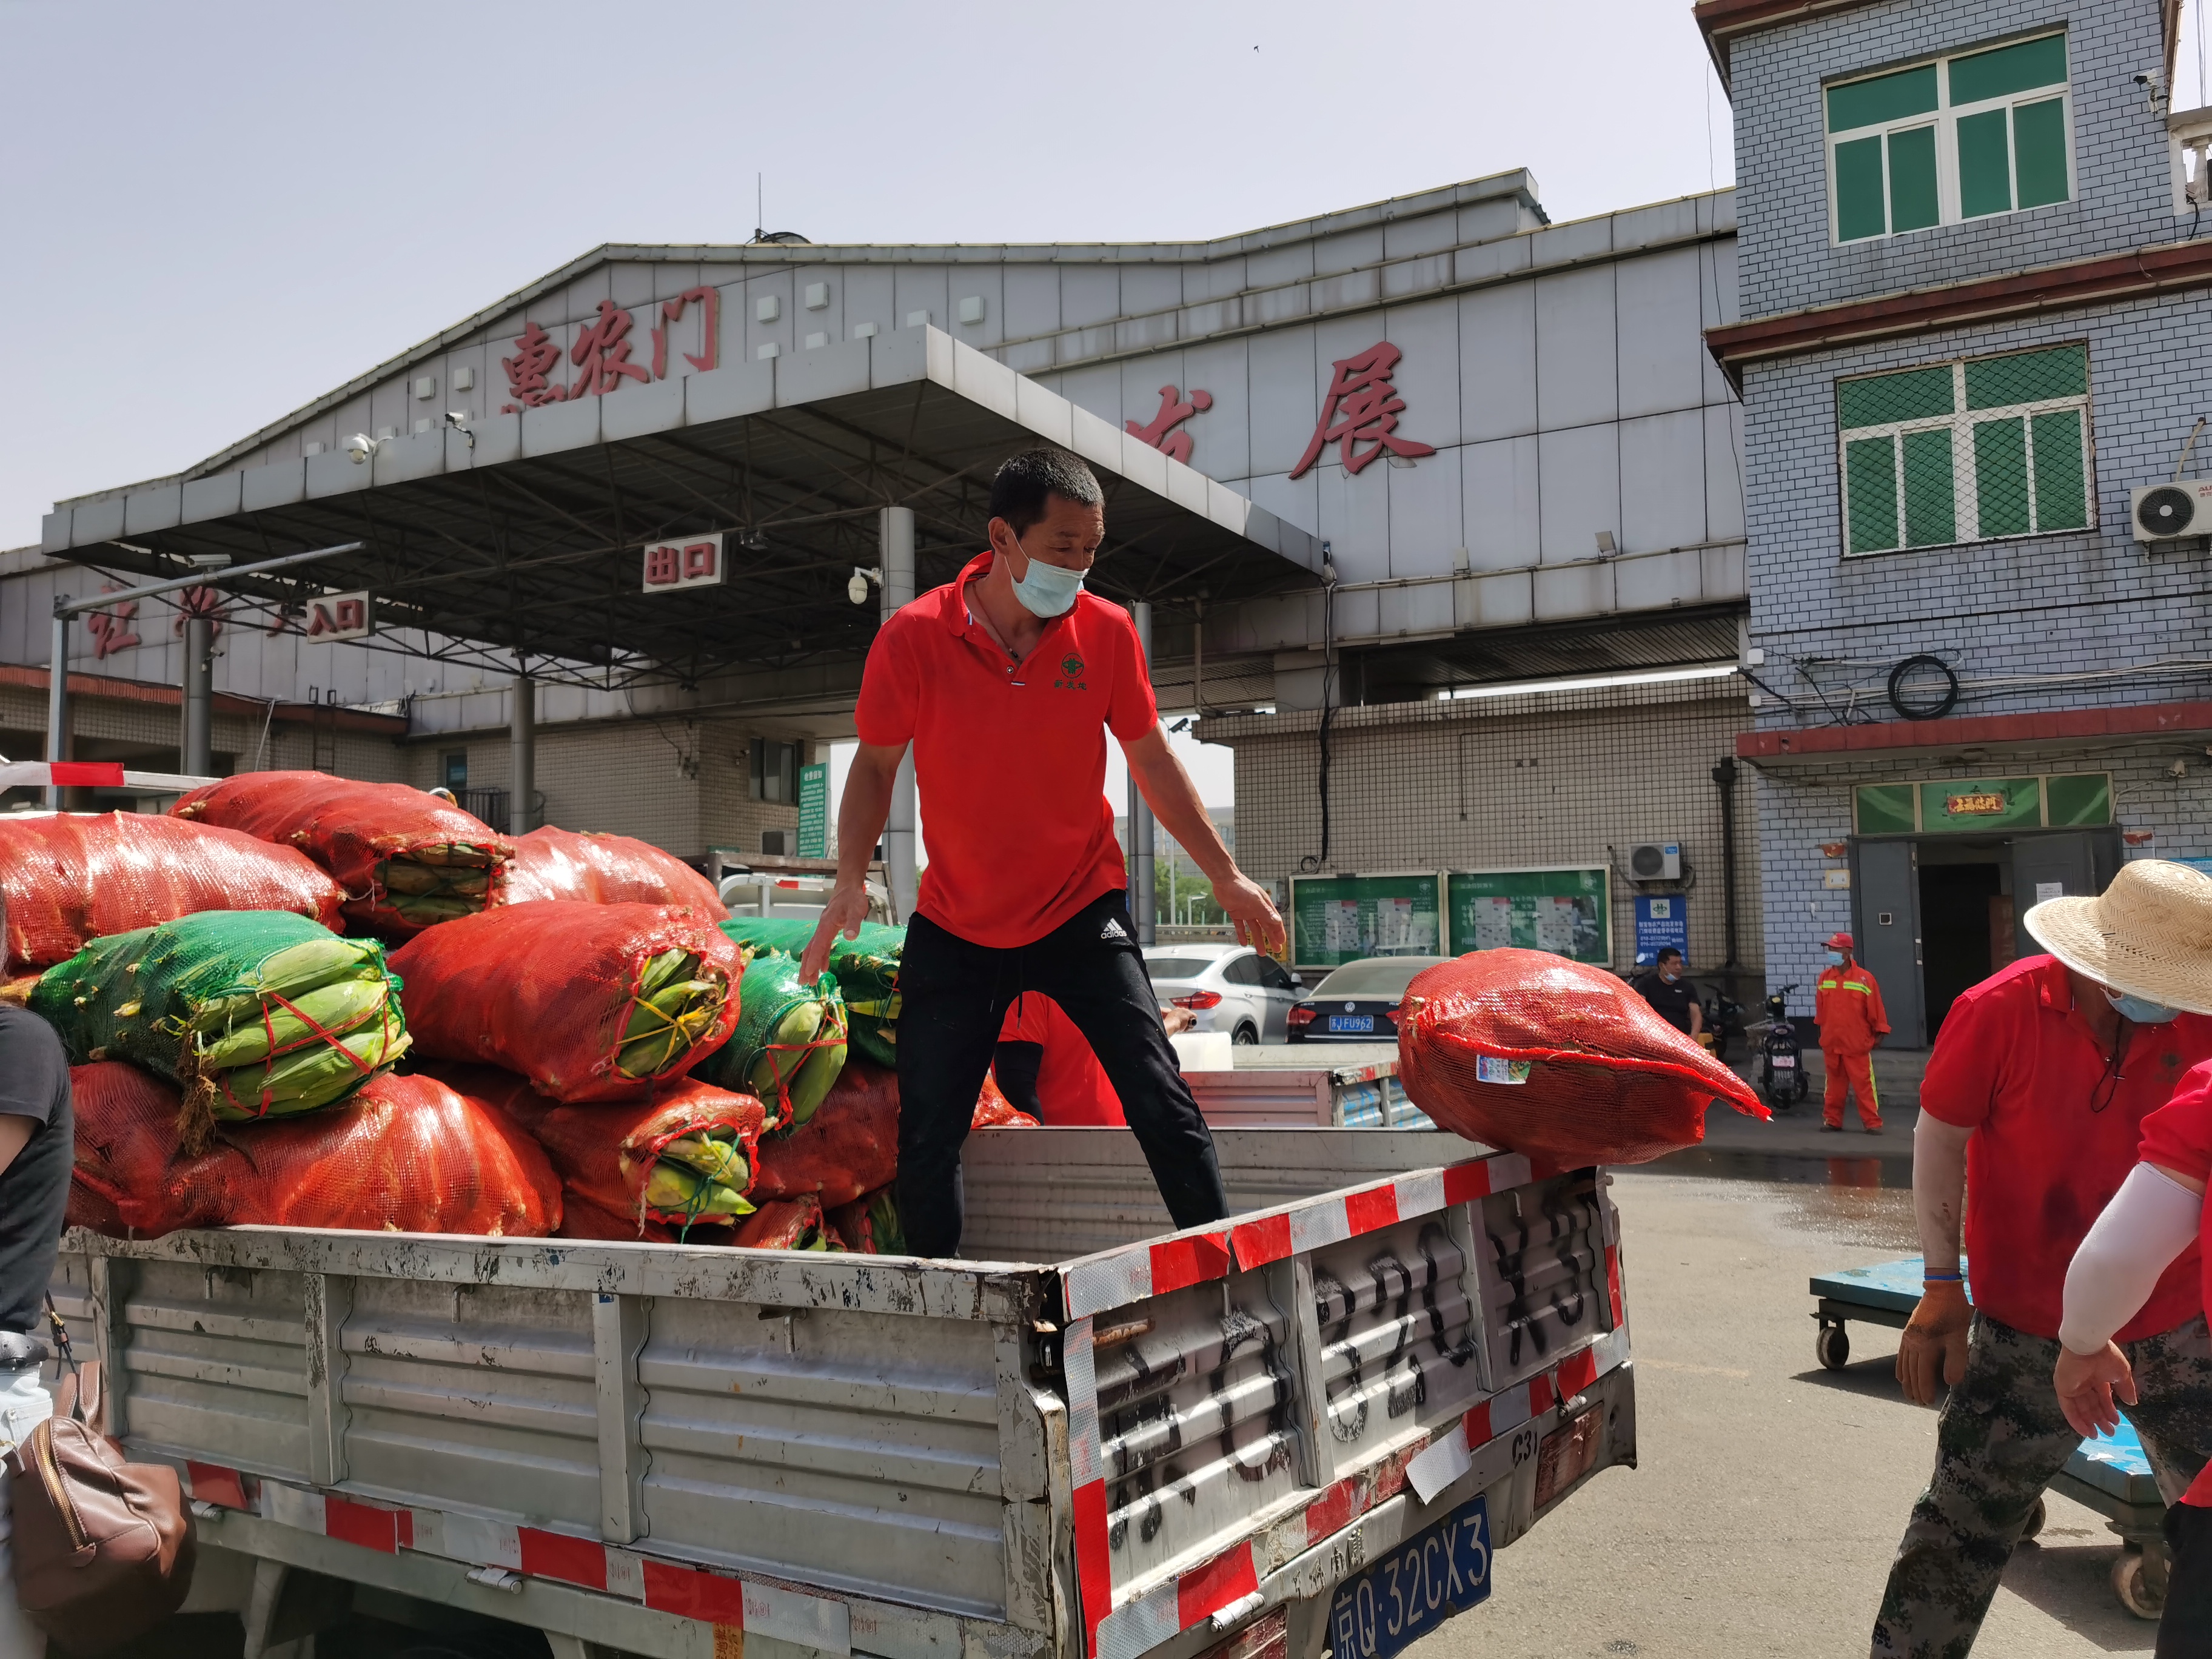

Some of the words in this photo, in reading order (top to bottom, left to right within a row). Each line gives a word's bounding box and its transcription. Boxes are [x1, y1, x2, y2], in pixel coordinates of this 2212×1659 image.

[501, 285, 720, 415] 惠农门
[645, 542, 716, 585] 出口
[308, 599, 364, 635] 入口
[1101, 930, 1127, 939] adidas
